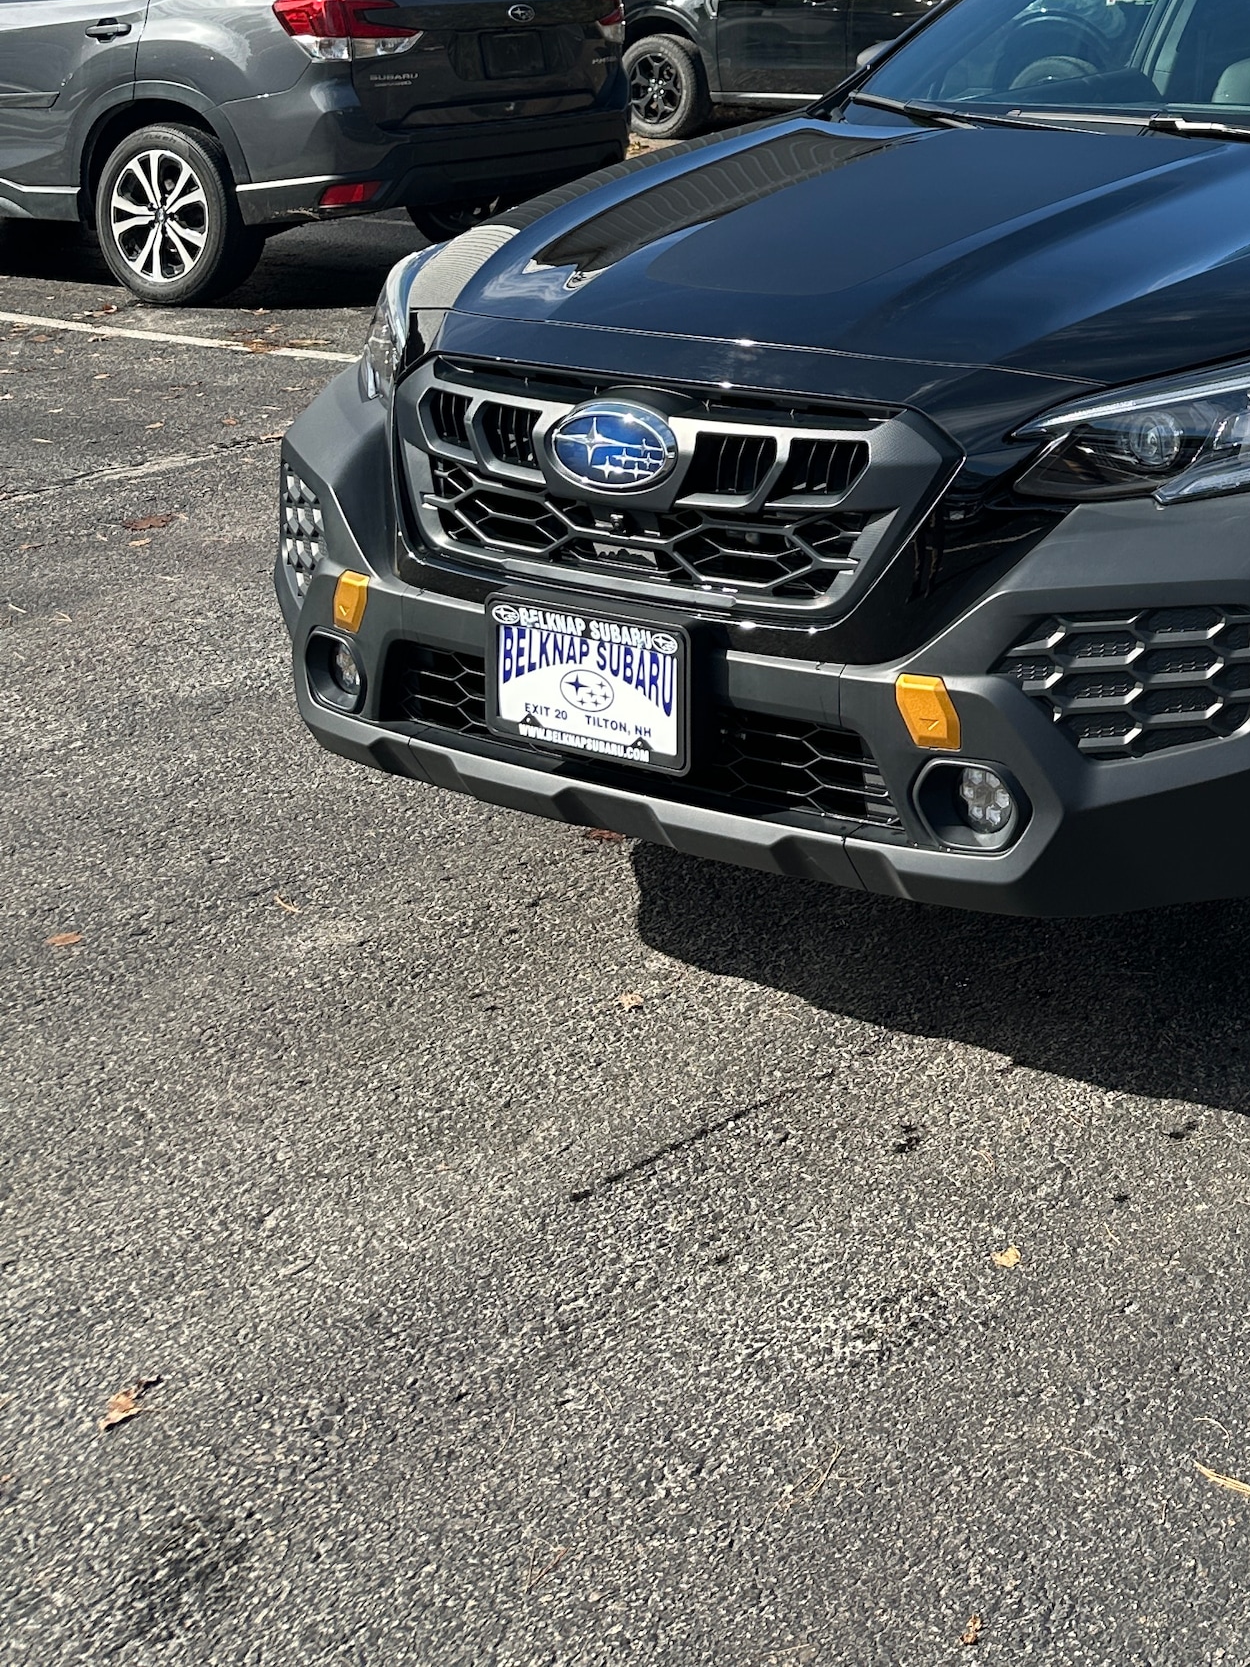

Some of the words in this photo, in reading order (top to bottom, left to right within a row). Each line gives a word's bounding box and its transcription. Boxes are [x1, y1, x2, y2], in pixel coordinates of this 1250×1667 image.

[518, 607, 586, 636] BELKNAP
[590, 620, 652, 650] SUBARU
[503, 626, 590, 684] BELKNAP
[596, 641, 674, 717] SUBARU
[524, 702, 551, 717] EXIT
[554, 709, 568, 720] 20
[584, 715, 631, 735] TILTON,
[635, 724, 652, 738] NH
[518, 723, 650, 763] WWW.BELKNAPSUBARU.COM
